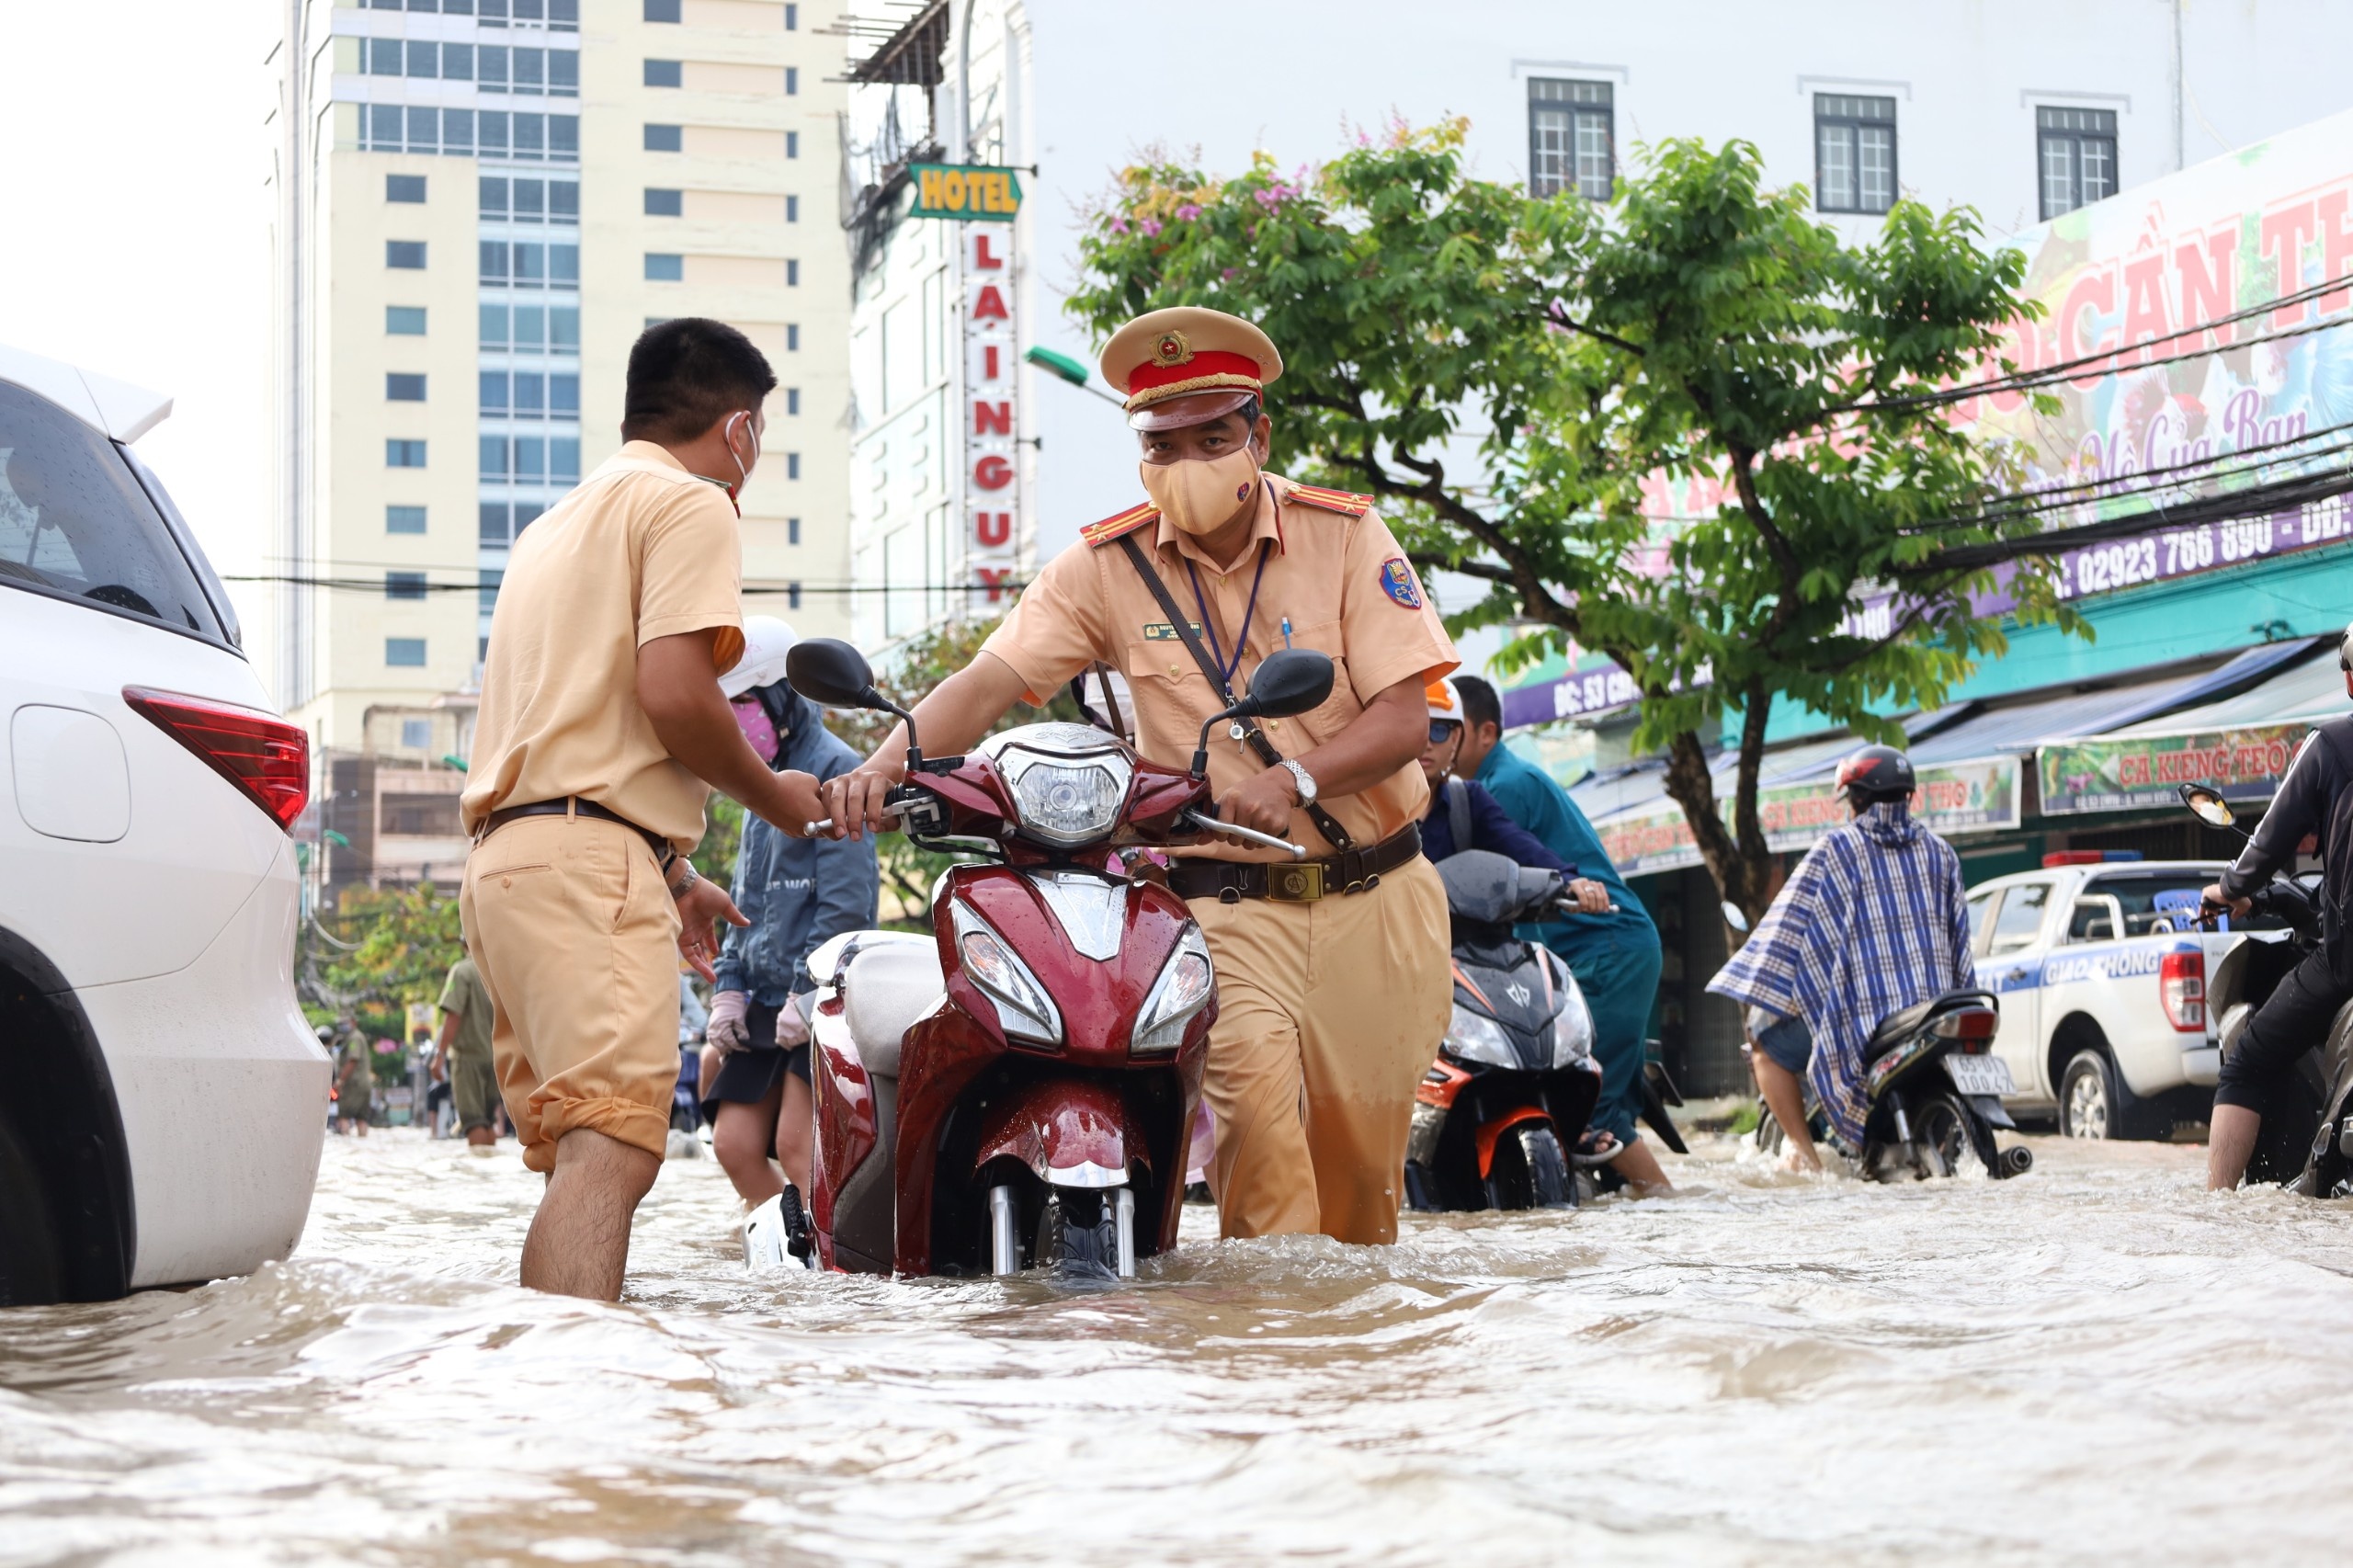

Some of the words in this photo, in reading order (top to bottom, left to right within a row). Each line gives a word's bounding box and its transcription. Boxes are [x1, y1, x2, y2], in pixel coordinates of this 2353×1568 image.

[920, 169, 1018, 213] HOTEL
[2077, 537, 2158, 595] 02923
[2221, 514, 2273, 562] 890
